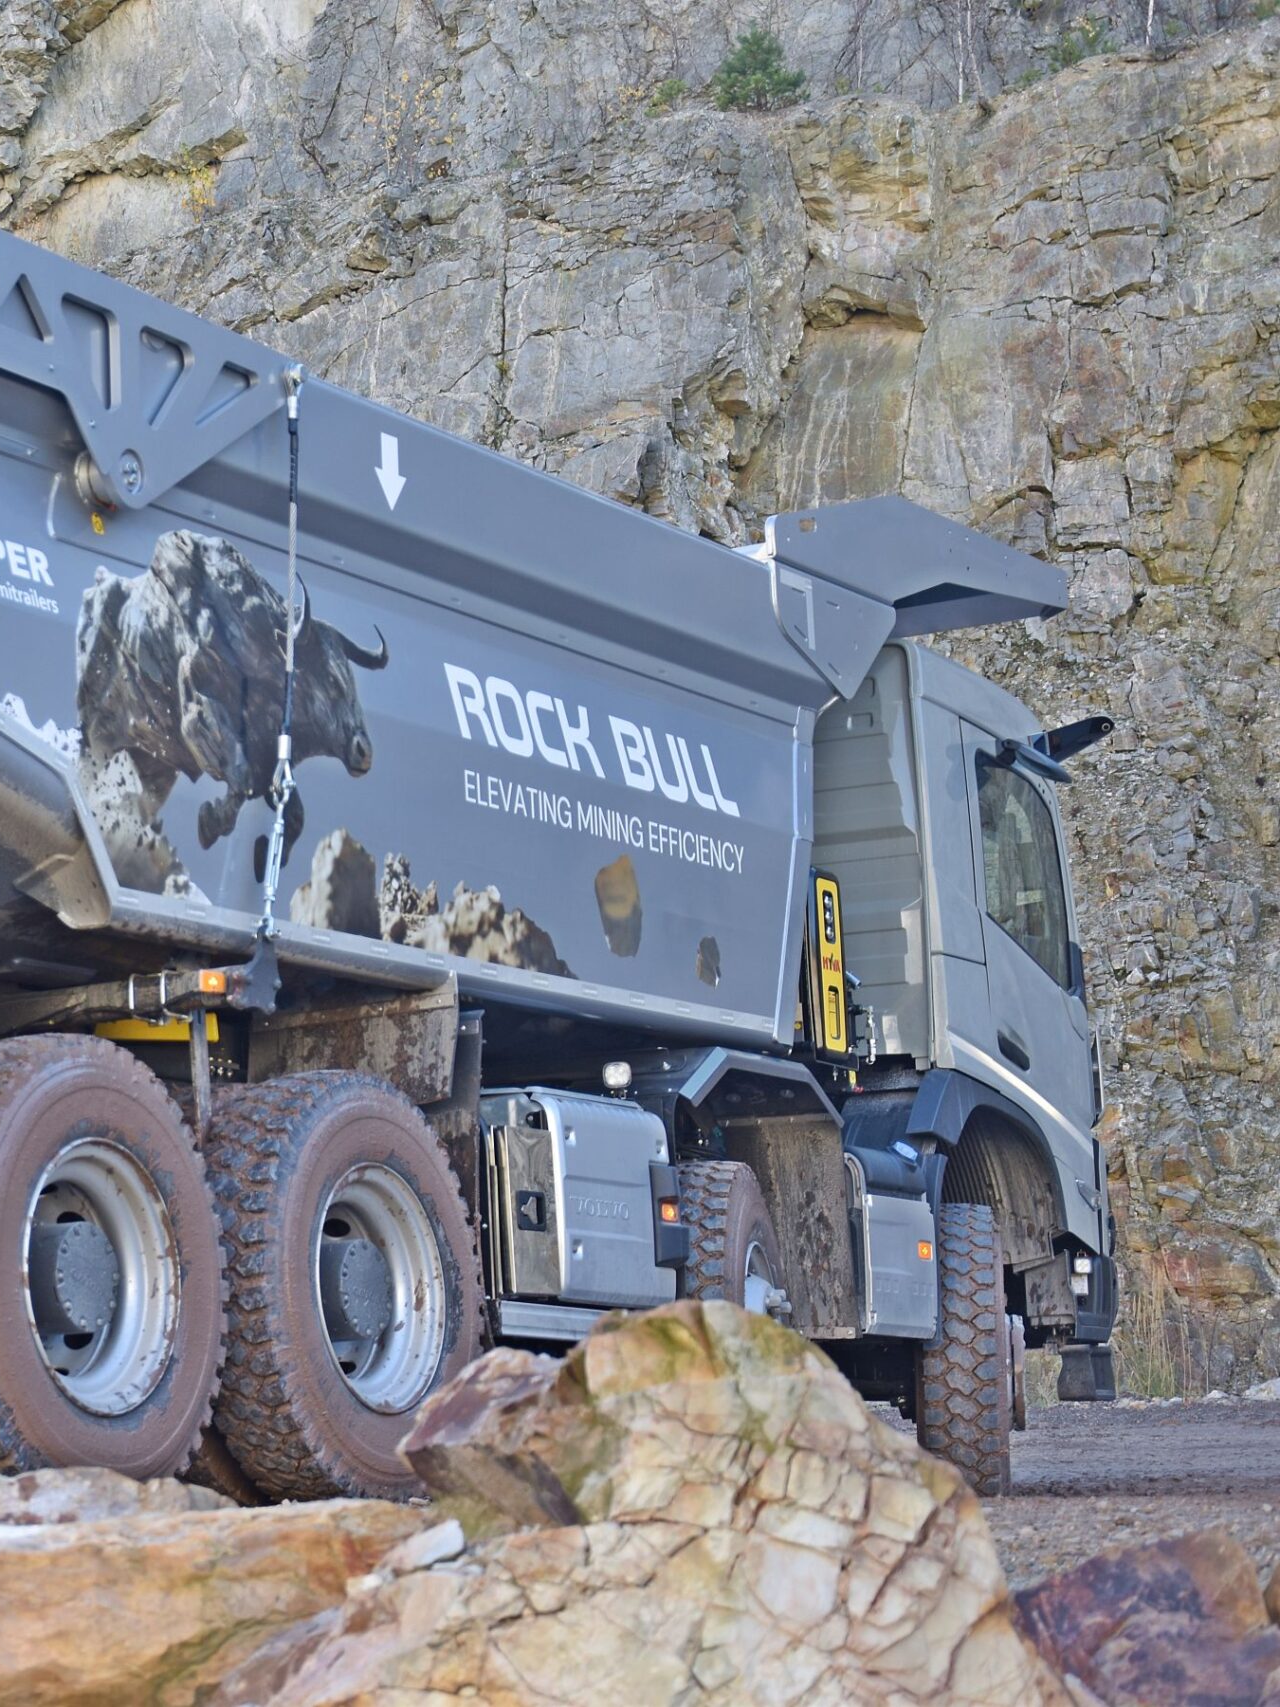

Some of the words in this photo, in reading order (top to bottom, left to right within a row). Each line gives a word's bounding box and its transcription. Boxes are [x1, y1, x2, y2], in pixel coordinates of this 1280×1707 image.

[443, 662, 606, 779] ROCK
[608, 715, 741, 818] BULL
[464, 769, 572, 829] ELEVATING
[577, 801, 644, 849] MINING
[648, 821, 744, 874] EFFICIENCY
[822, 953, 841, 974] HYVA
